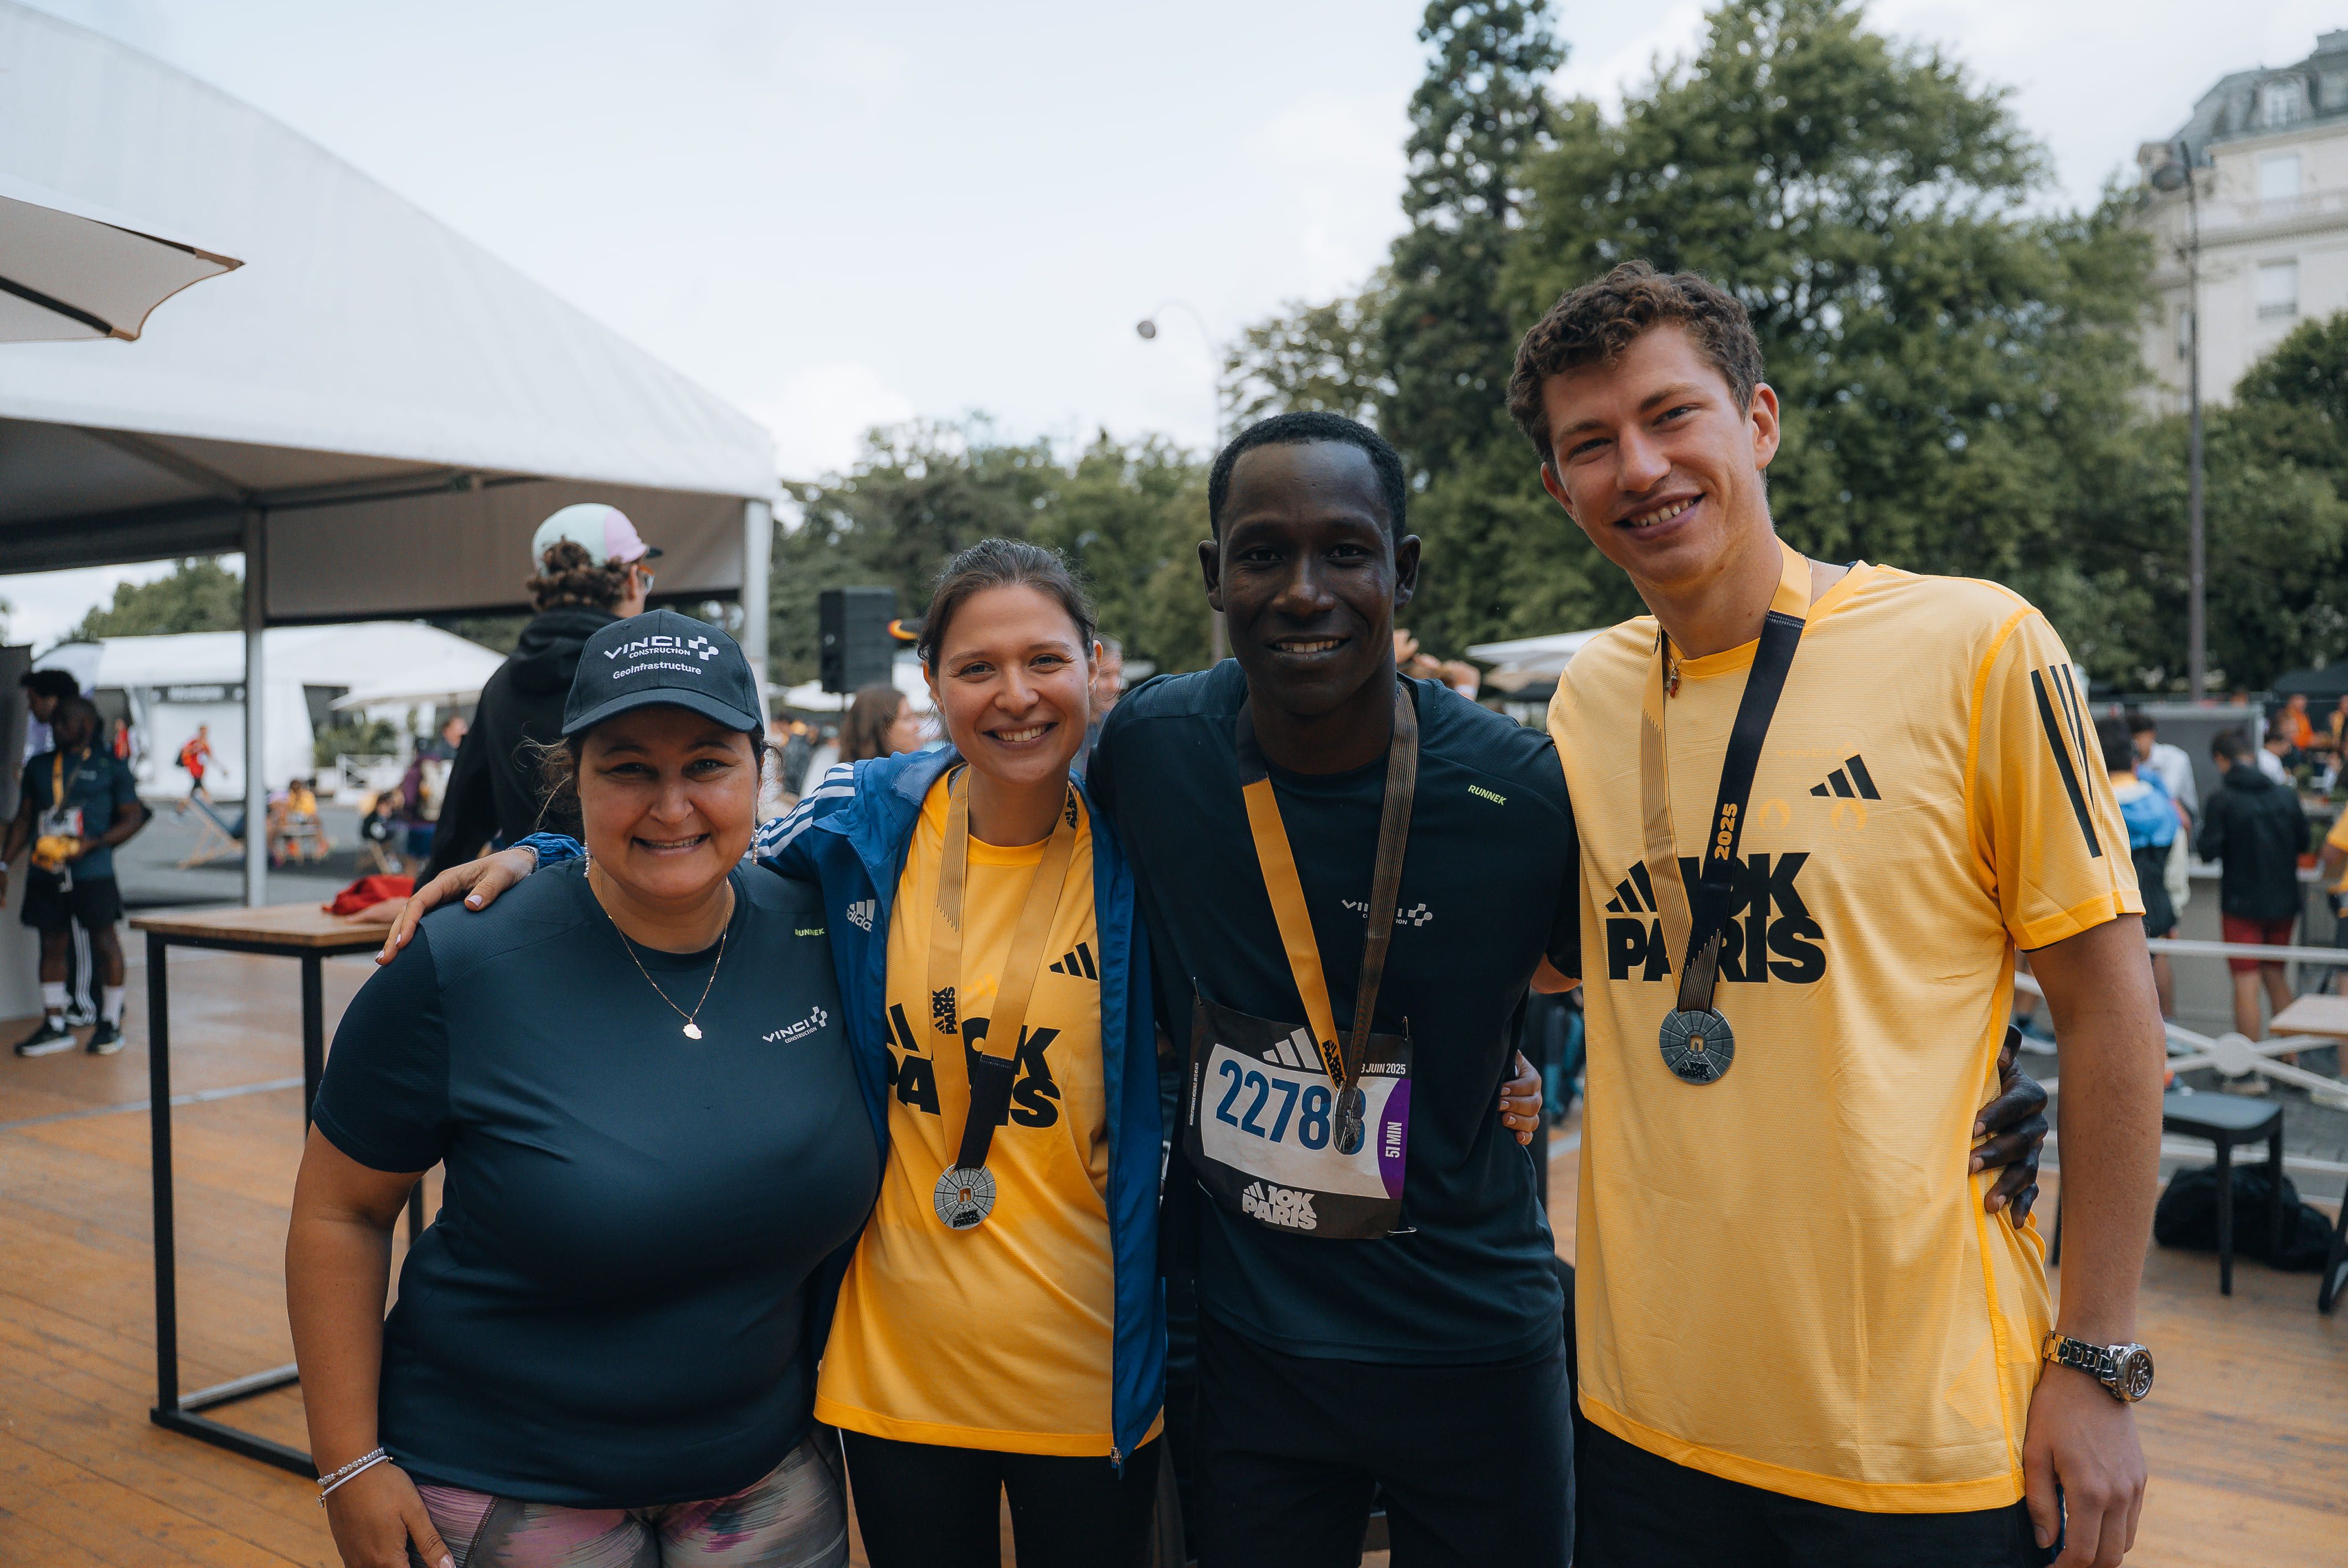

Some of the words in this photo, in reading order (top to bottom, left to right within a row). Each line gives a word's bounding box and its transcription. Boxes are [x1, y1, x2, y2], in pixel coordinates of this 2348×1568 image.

[604, 636, 681, 659] VINCI
[629, 647, 691, 658] CONSTRUCTION
[1468, 785, 1507, 806] RUNNEK
[1714, 803, 1738, 860] 2025
[795, 928, 825, 936] RUNNEK
[944, 986, 958, 1034] PARIS
[763, 1019, 810, 1043] VINCI
[785, 1026, 817, 1044] CONSTRUCTION
[1366, 1063, 1386, 1073] JUIN
[1386, 1063, 1406, 1075] 2025
[1386, 1121, 1402, 1146] MIN
[1386, 1146, 1400, 1158] 51
[1268, 1185, 1315, 1211] 10K
[1243, 1193, 1317, 1229] PARIS
